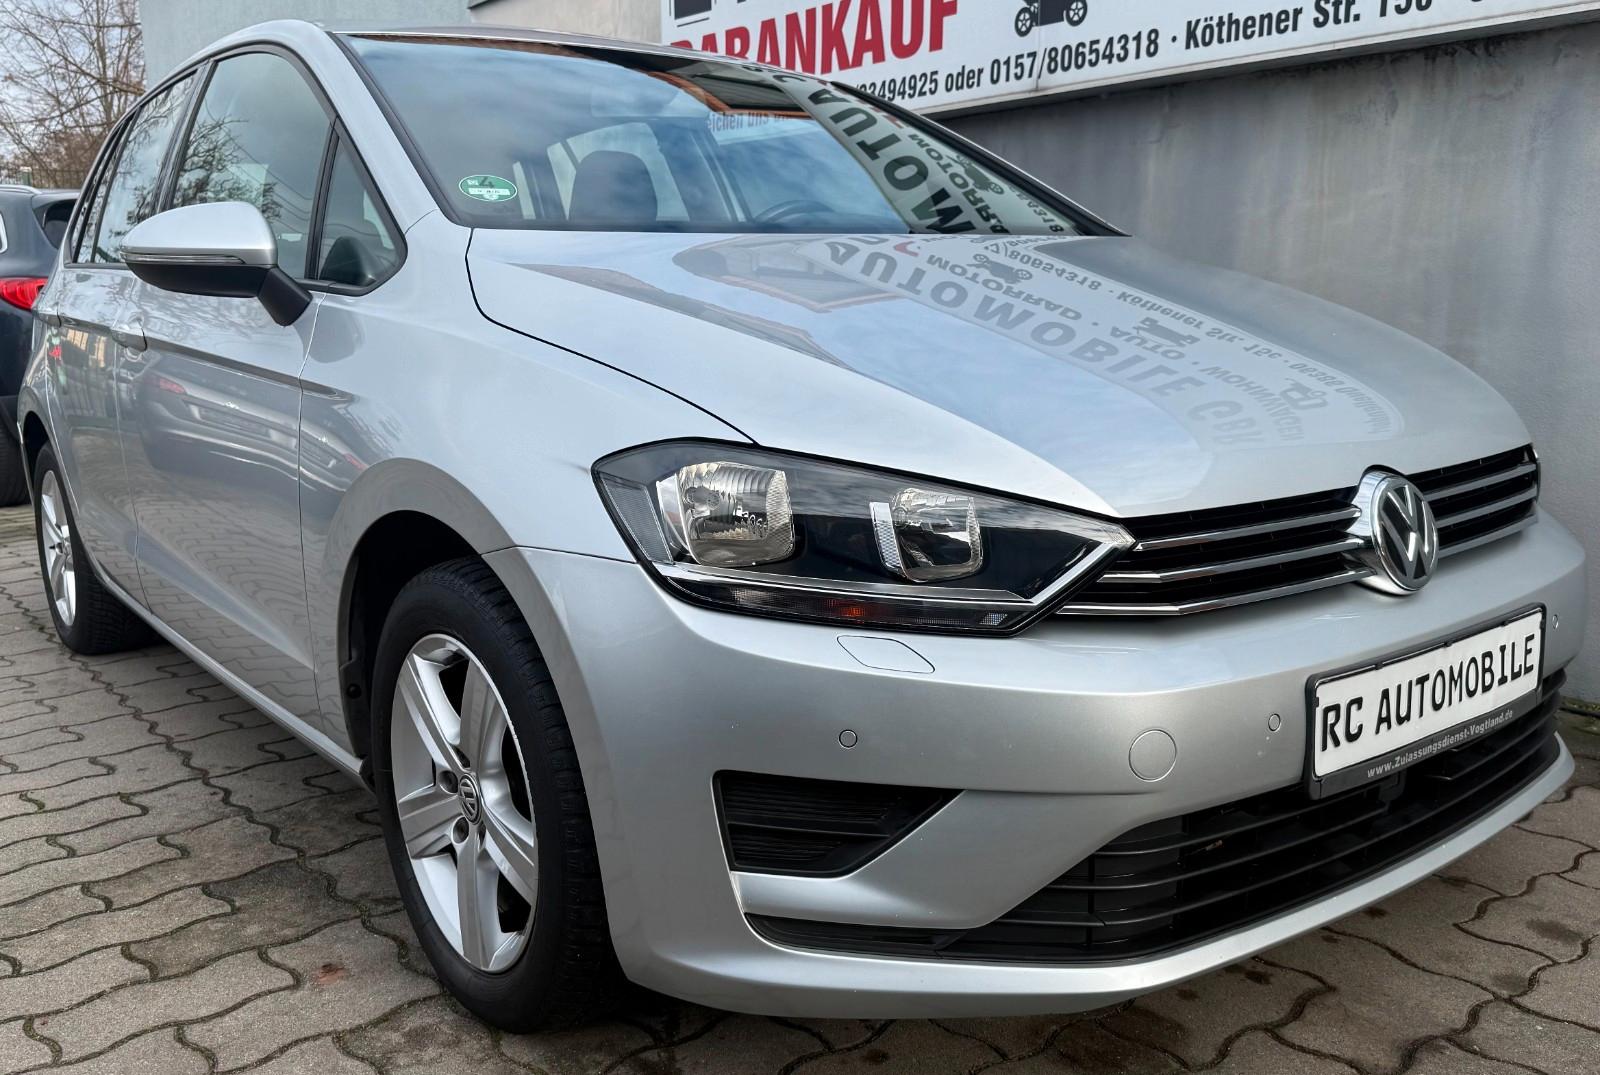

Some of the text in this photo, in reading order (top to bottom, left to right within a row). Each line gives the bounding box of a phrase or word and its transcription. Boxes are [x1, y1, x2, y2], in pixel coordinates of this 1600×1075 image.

[945, 65, 984, 92] oder
[990, 28, 1160, 84] 0157/80654318
[1185, 7, 1303, 50] Köthener
[1313, 0, 1360, 28] Str.
[1321, 633, 1535, 752] RC AUTOMOBILE
[1367, 709, 1513, 778] www.Zulassungsdienst-Vogtland.de
